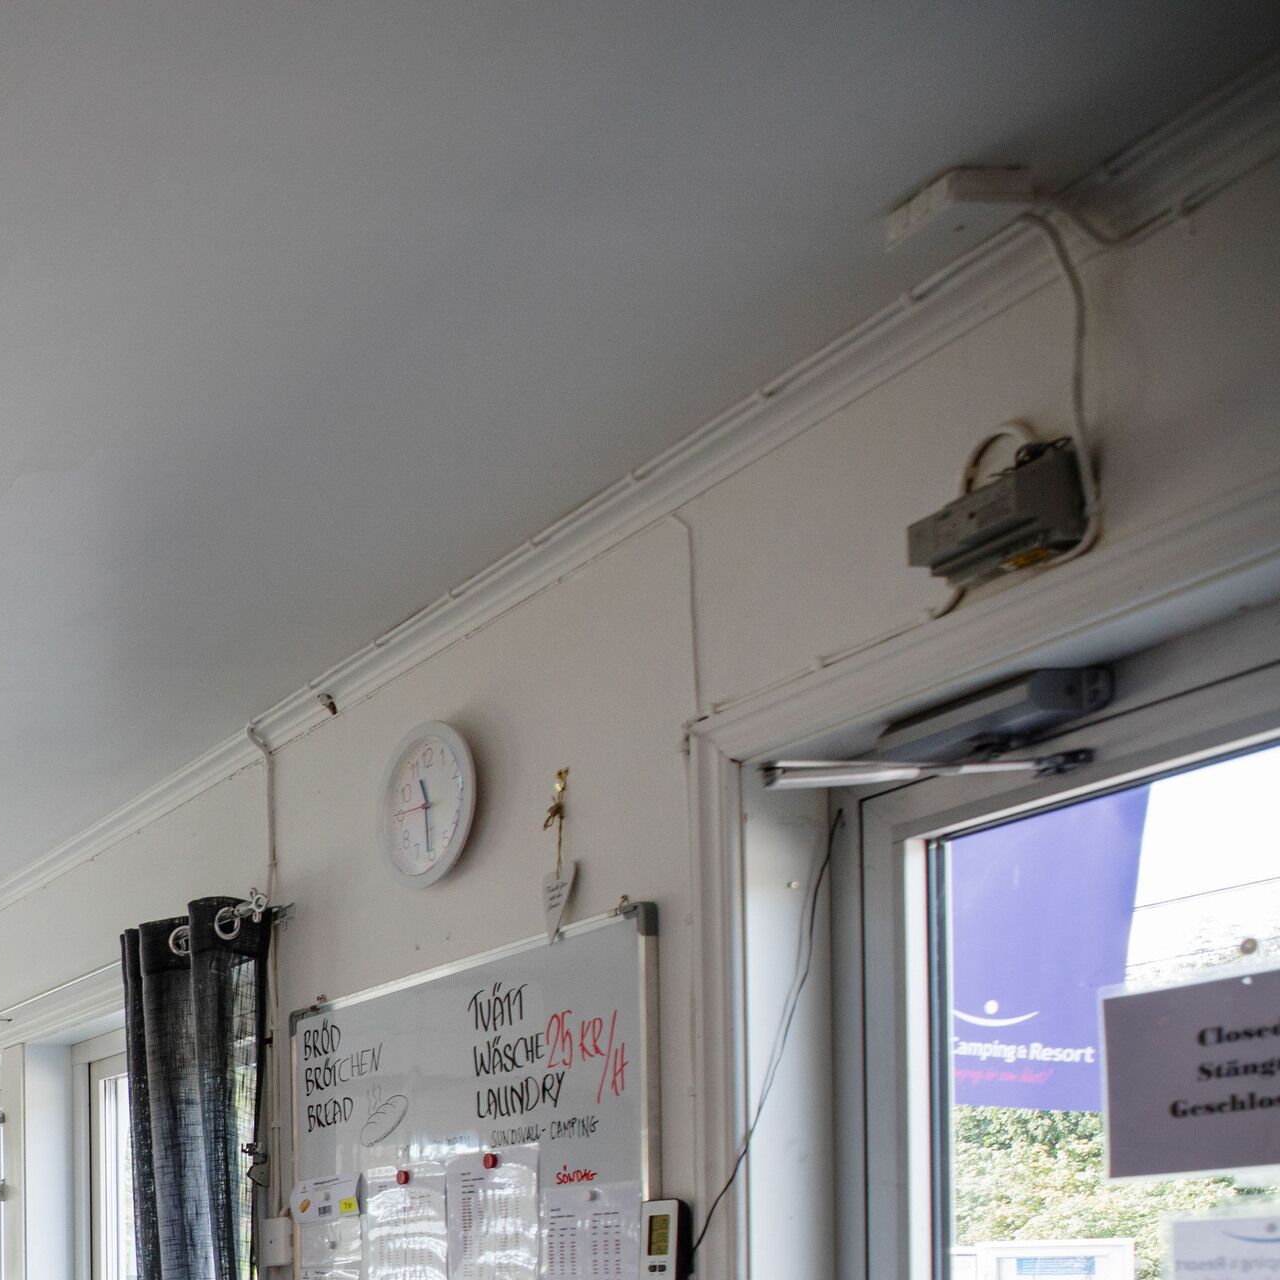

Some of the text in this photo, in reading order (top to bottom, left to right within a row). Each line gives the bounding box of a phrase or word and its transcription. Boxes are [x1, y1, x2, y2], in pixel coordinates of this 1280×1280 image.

[468, 982, 530, 1033] TVÄTT
[303, 1017, 341, 1062] BRÖD
[472, 1030, 545, 1079] WÄSCHE
[545, 1008, 573, 1070] 25
[1028, 1042, 1097, 1063] Resort
[304, 1042, 384, 1098] BRÖTCHEN
[306, 1095, 355, 1133] BREAD
[476, 1070, 567, 1121] LAUNDRY
[549, 1115, 600, 1142] CAMPING
[555, 1163, 597, 1186] SÖNDAG
